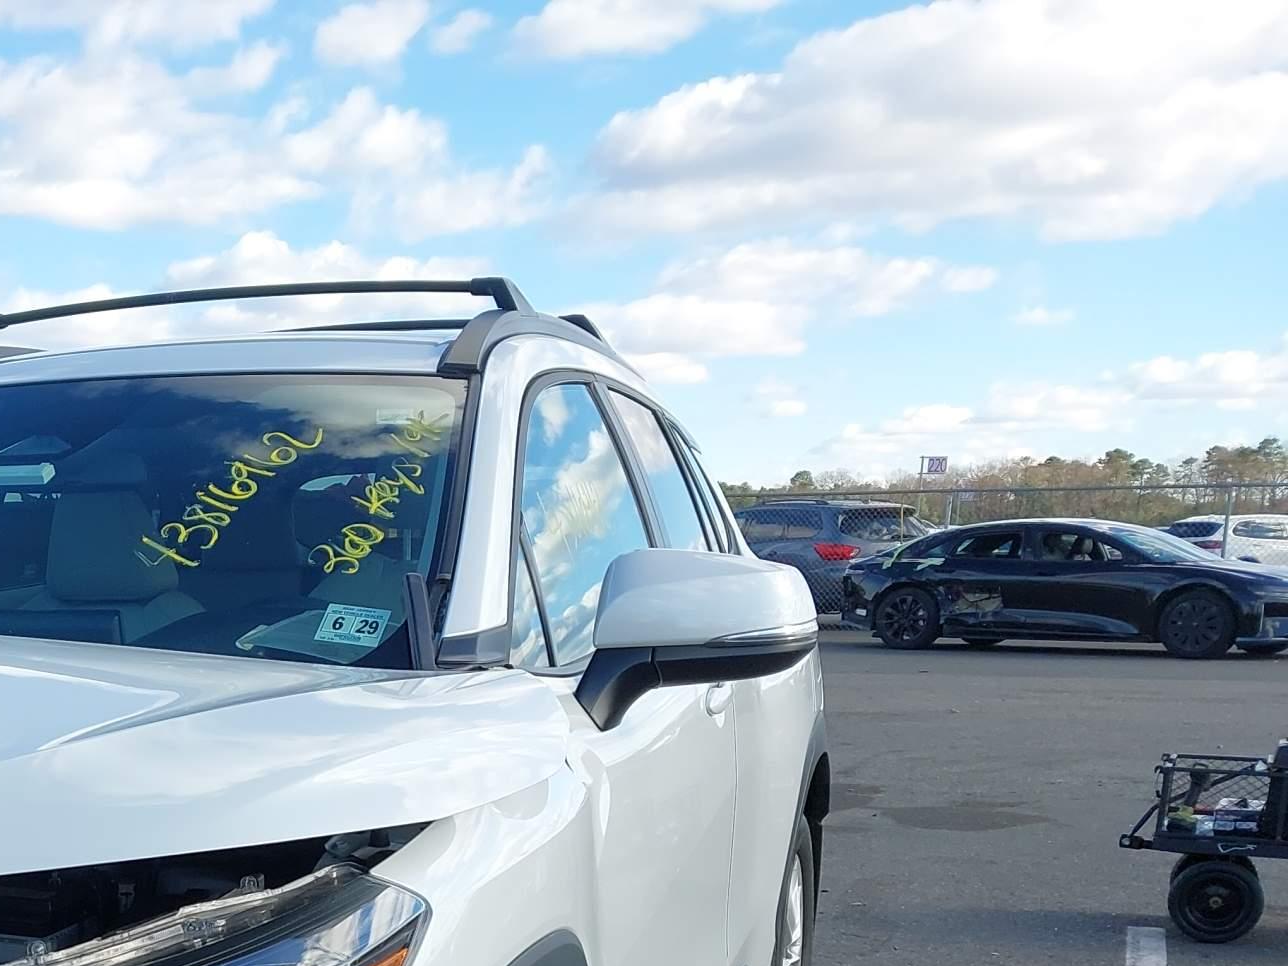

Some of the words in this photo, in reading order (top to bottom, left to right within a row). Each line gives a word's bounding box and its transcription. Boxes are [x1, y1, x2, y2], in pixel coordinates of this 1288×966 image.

[927, 458, 947, 473] 220
[135, 428, 324, 567] 43816962
[331, 616, 345, 631] 6
[354, 619, 380, 635] 29
